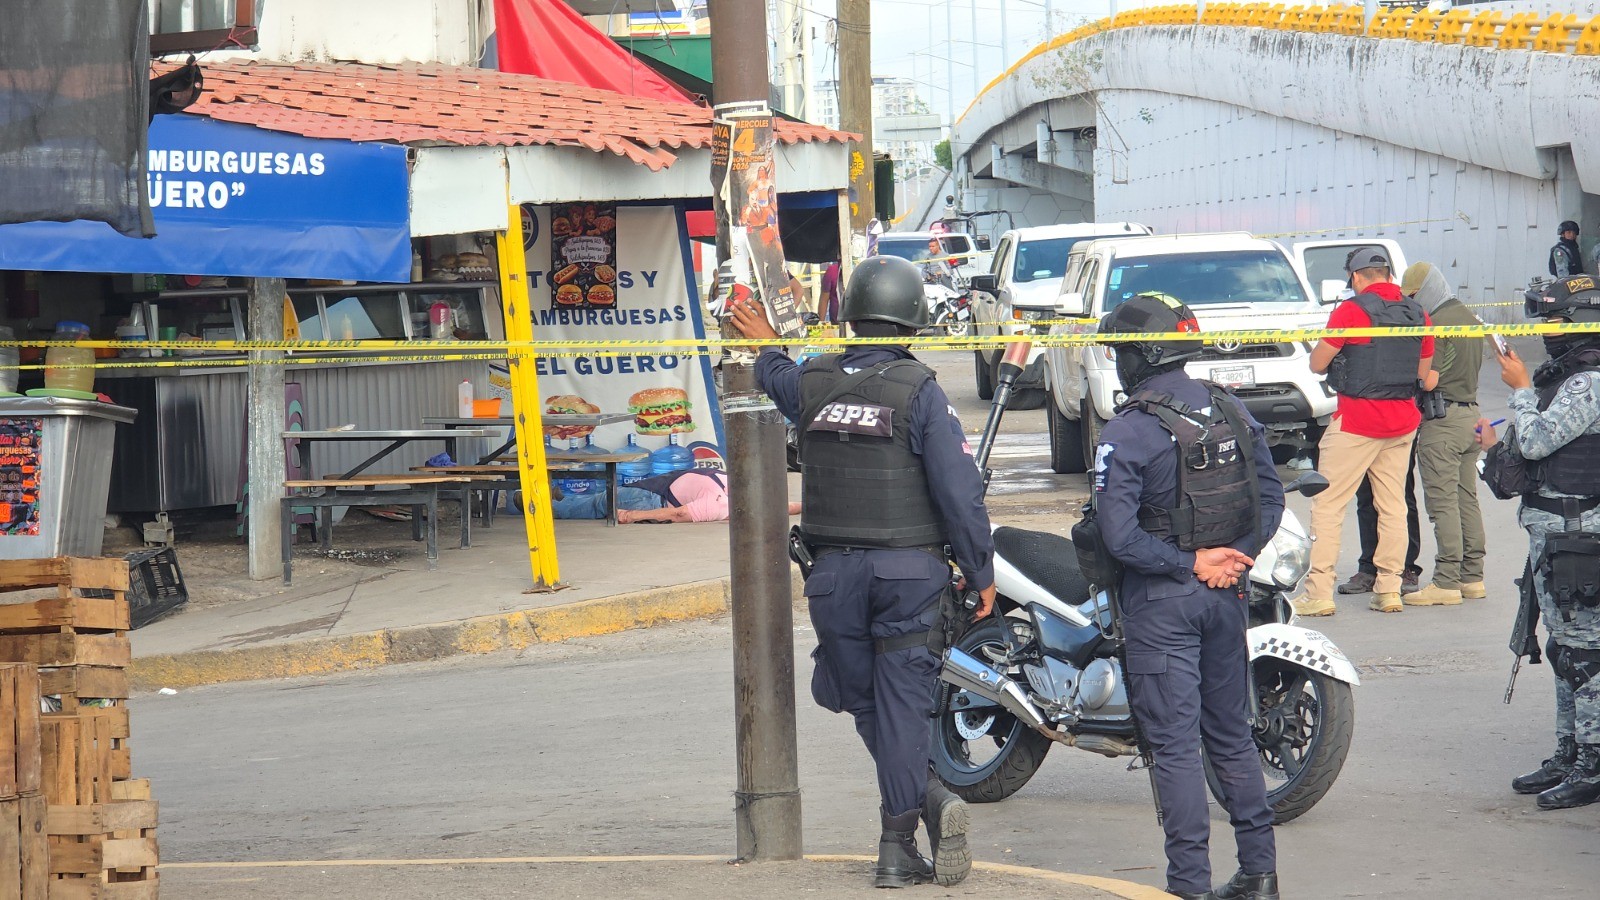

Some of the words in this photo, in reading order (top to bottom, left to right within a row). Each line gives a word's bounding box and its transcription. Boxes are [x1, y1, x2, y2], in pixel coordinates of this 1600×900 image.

[734, 129, 756, 156] 4
[640, 270, 659, 289] Y
[814, 404, 880, 427] FSPE
[1218, 439, 1236, 453] FSPE
